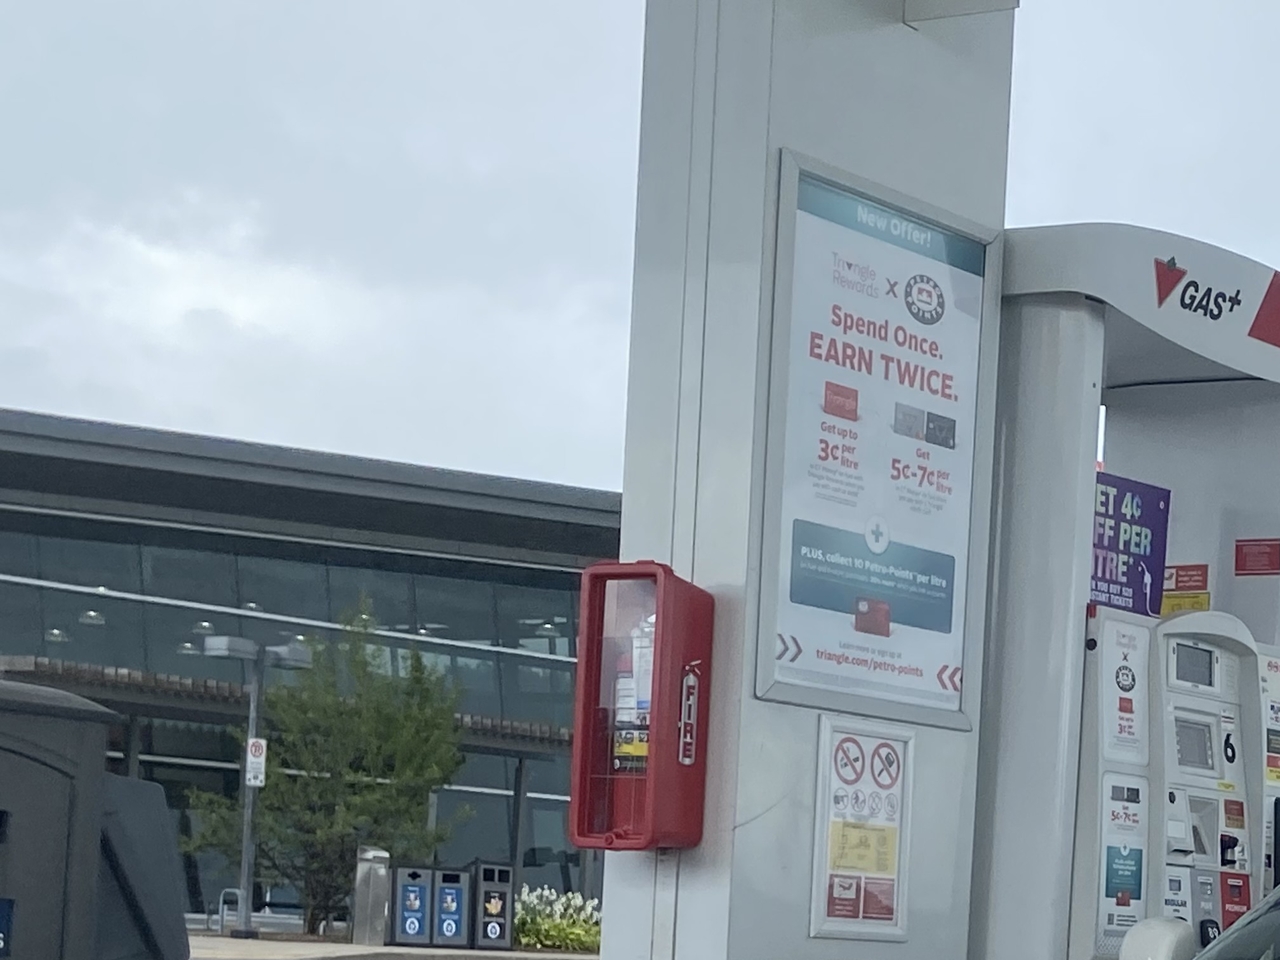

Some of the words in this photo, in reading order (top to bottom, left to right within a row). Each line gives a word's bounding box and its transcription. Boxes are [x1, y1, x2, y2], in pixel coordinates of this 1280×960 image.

[857, 204, 886, 228] New
[890, 217, 932, 248] Offer!
[833, 269, 880, 299] Rewards
[831, 303, 889, 342] Spend
[893, 324, 943, 361] Once.
[809, 330, 873, 376] EARN
[880, 353, 958, 402] TWICE.
[820, 421, 836, 435] Get
[837, 427, 848, 440] up
[849, 428, 858, 440] to
[818, 438, 840, 462] 3¢
[840, 456, 859, 470] litre
[841, 444, 856, 455] per
[915, 448, 930, 460] Get
[890, 458, 935, 488] 5¢-7¢
[936, 470, 950, 481] per
[935, 481, 953, 496] litre
[1096, 483, 1117, 515] ET
[1121, 492, 1142, 520] 4¢
[1093, 515, 1115, 546] FF
[1118, 521, 1152, 556] PER
[801, 545, 825, 563] PLUS,
[826, 552, 852, 568] collect
[854, 558, 864, 570] 10
[917, 573, 930, 585] per
[930, 574, 947, 588] litre
[816, 649, 923, 678] triangle.com/petro-points
[683, 684, 696, 759] FIRE
[1223, 733, 1236, 764] 6
